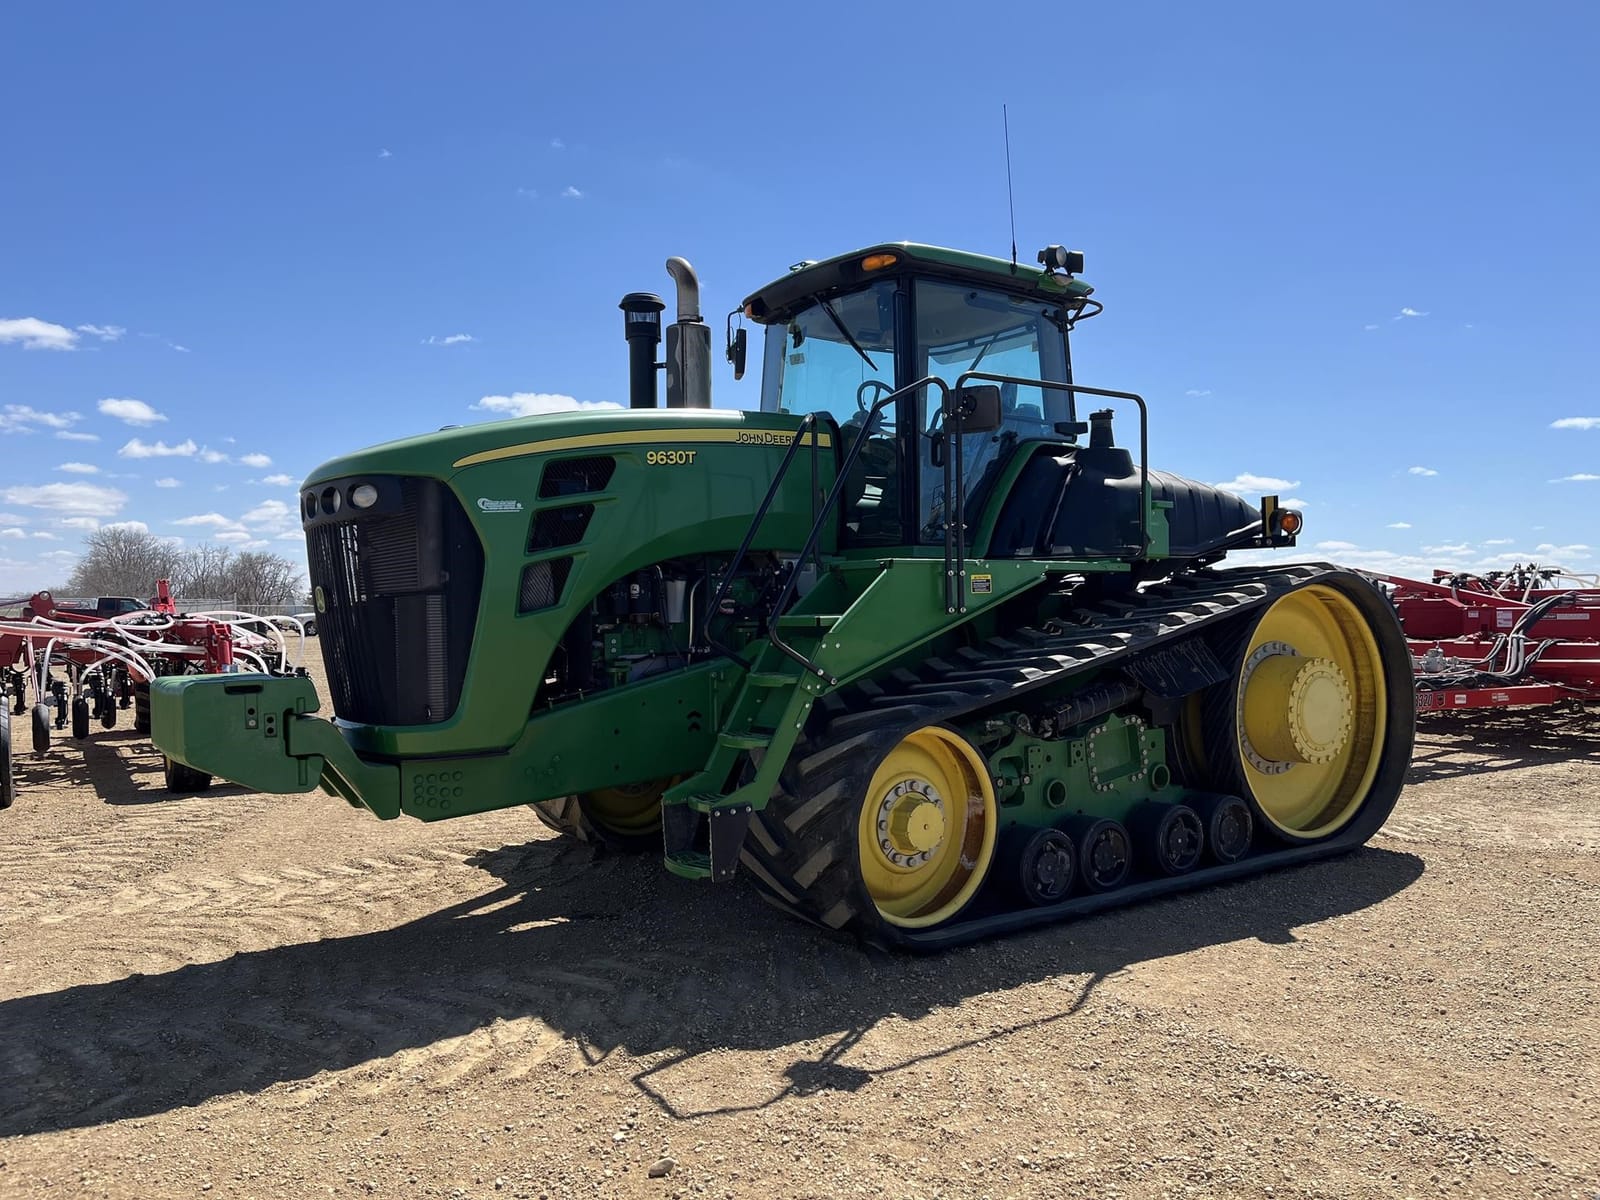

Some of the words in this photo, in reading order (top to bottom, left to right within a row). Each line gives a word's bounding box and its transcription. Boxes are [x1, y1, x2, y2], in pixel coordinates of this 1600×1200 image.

[736, 431, 763, 443] JOHN
[764, 432, 795, 445] DEER
[646, 450, 696, 465] 9630T
